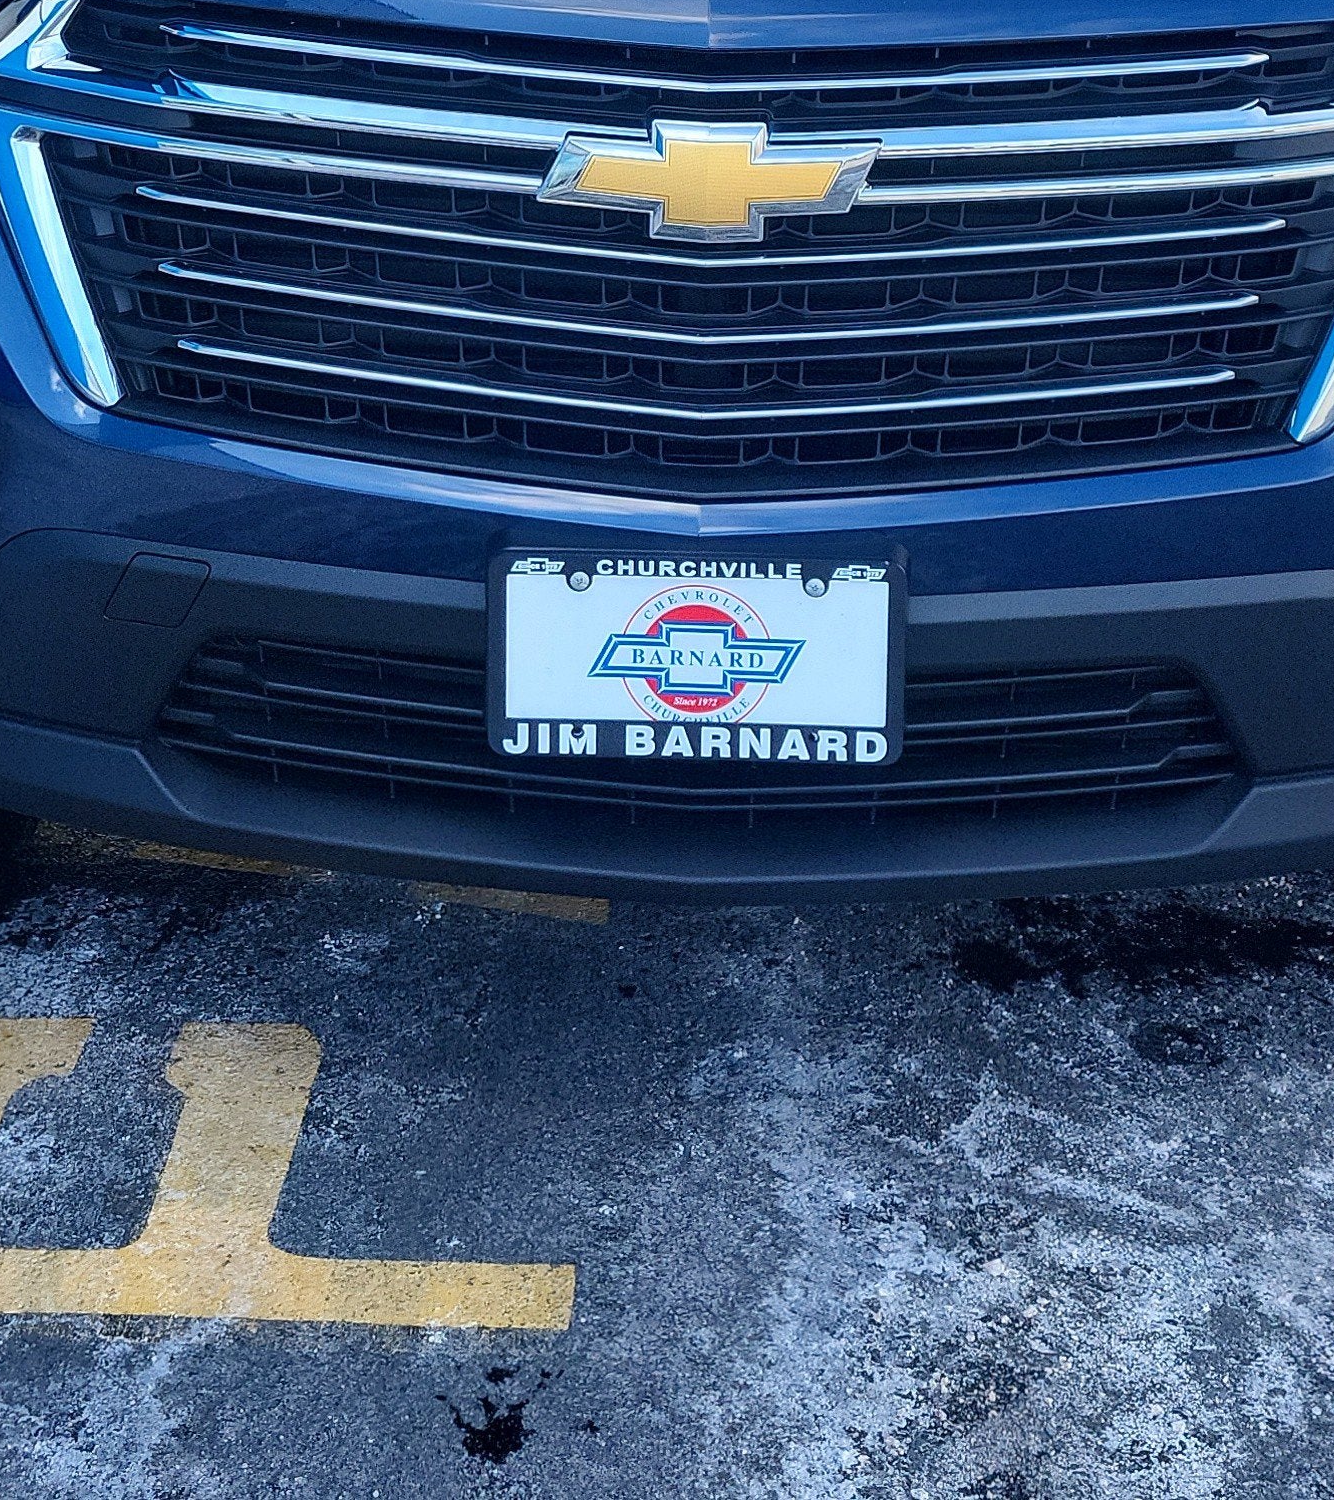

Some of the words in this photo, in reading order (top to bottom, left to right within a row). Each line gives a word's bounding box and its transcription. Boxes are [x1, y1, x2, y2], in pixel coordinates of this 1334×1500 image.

[596, 559, 803, 580] CHURCHVILLE
[643, 590, 754, 625] CHEVROLET
[632, 648, 764, 669] BARNARD
[673, 696, 696, 707] Since
[502, 722, 598, 755] JIM
[624, 724, 888, 763] BARNARD
